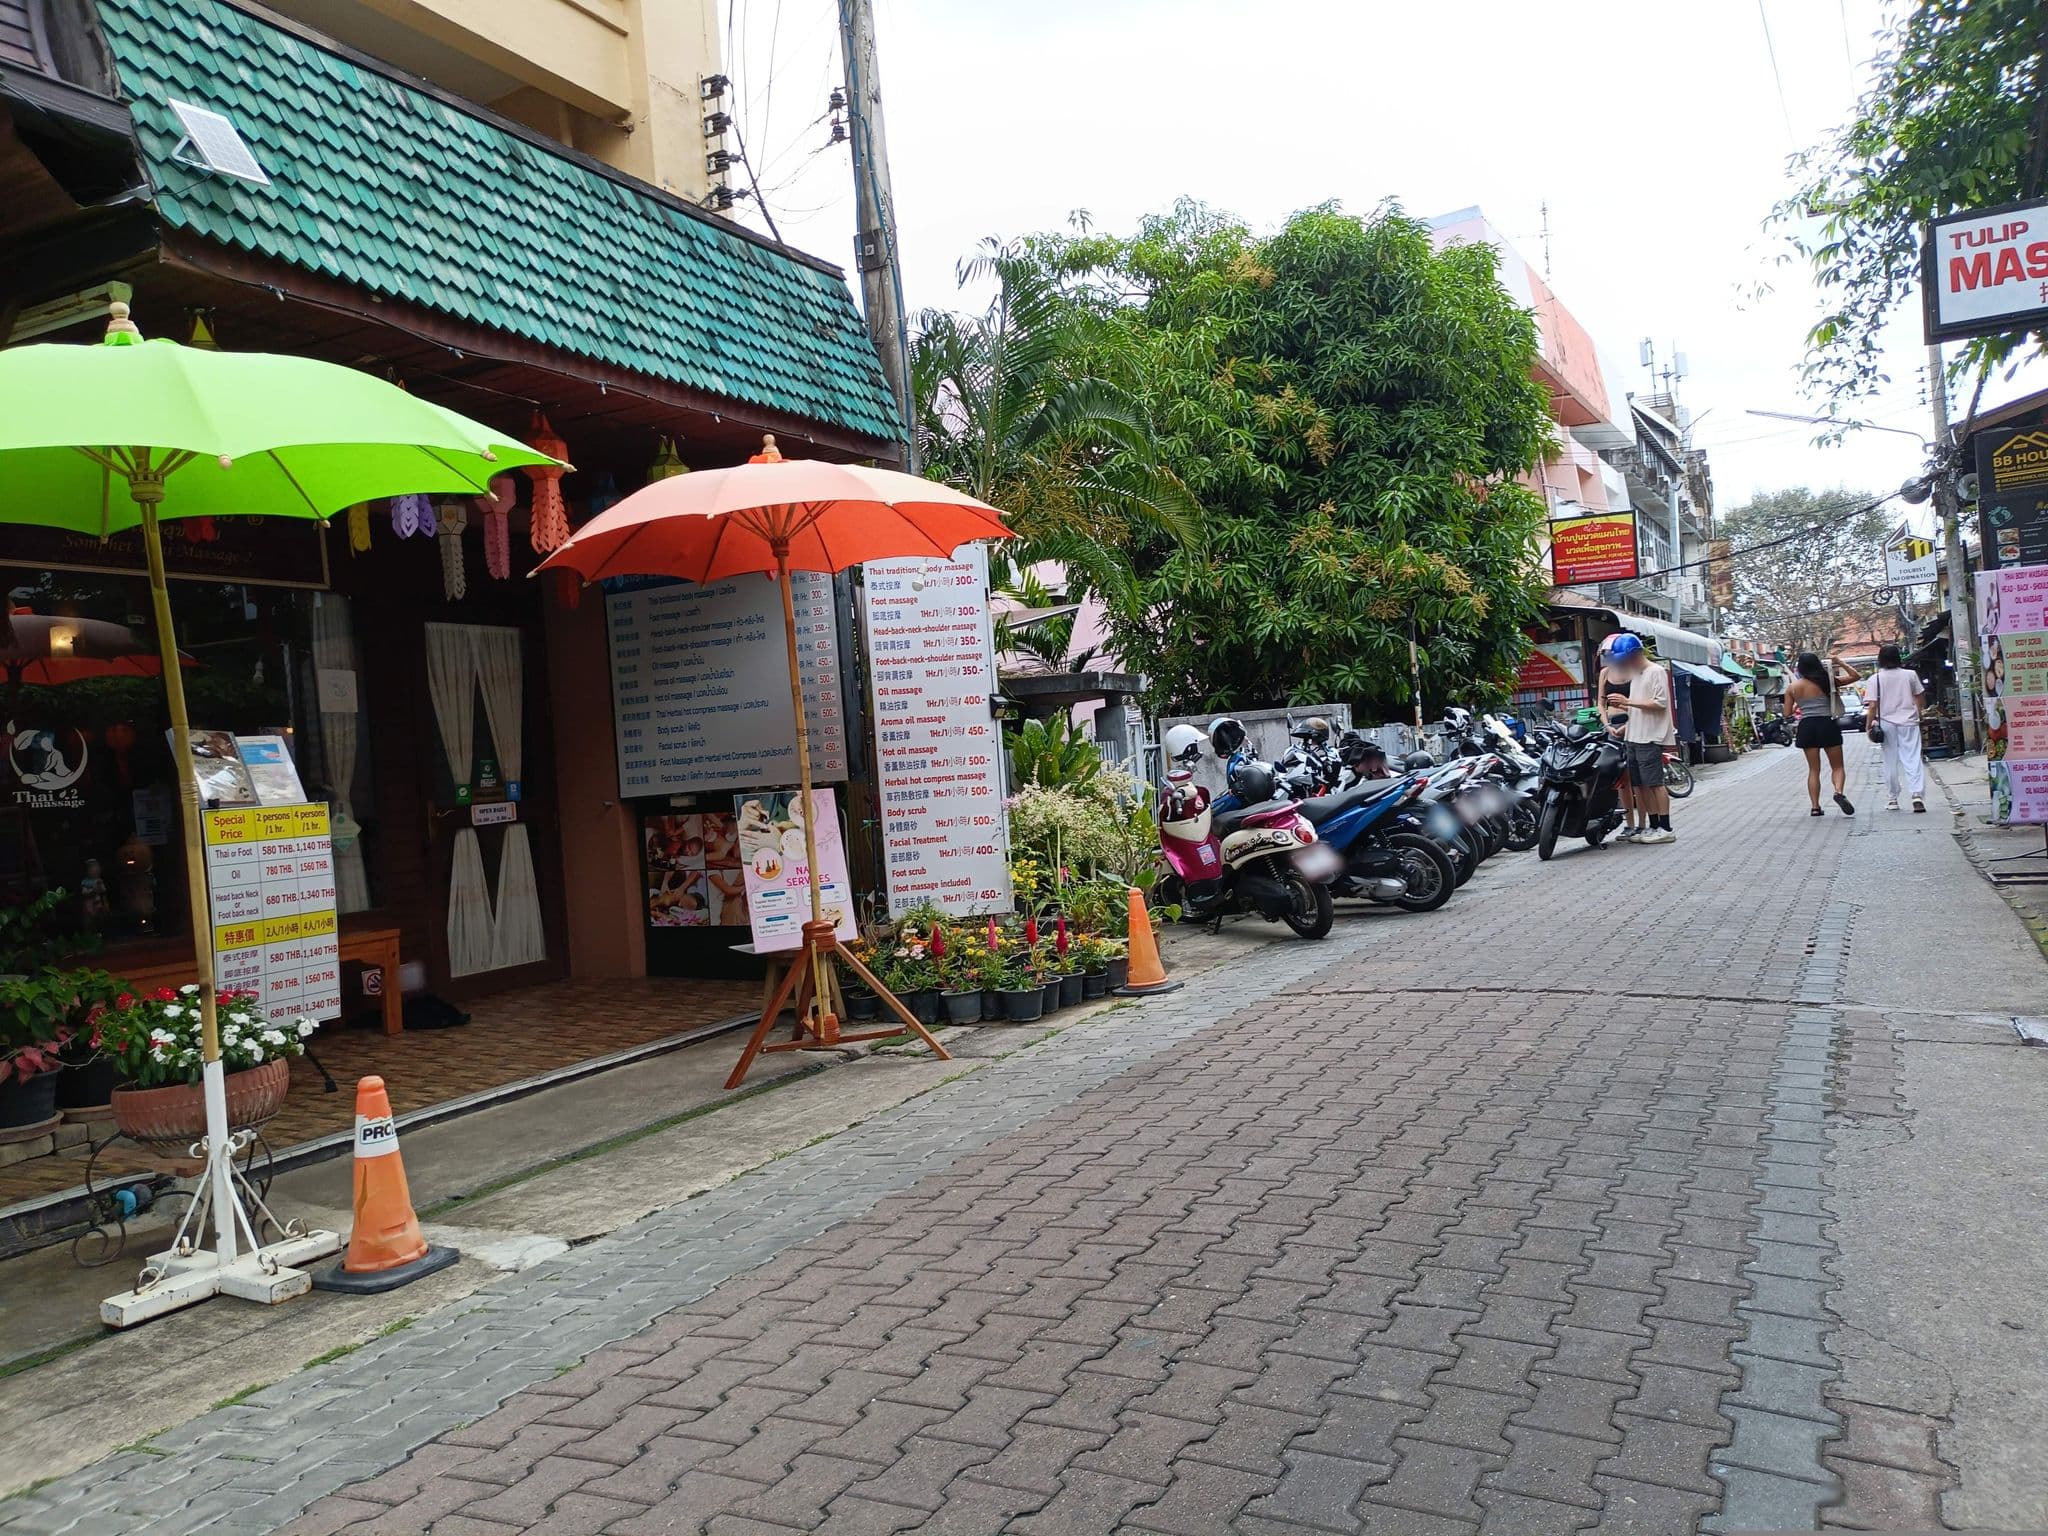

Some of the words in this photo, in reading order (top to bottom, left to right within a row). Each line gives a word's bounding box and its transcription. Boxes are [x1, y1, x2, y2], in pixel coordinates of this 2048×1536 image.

[1949, 221, 2029, 250] TULIP
[1949, 241, 2048, 293] MAS
[1993, 455, 2013, 468] BB
[868, 567, 884, 576] Thai
[944, 563, 974, 572] massage
[955, 575, 978, 586] 300.-
[1891, 573, 1935, 581] INFORMATION
[889, 596, 918, 606] massage
[957, 606, 981, 616] 300.-
[873, 623, 951, 636] Head-back-neck-shoulder
[952, 622, 977, 631] massage
[960, 636, 981, 646] 350.-
[875, 653, 955, 666] Foot-back-neck-shoulder
[956, 652, 983, 661] massage
[962, 665, 984, 675] 350.-
[878, 688, 889, 696] Oil
[891, 687, 923, 696] massage
[964, 695, 986, 705] 400.-
[881, 717, 904, 726] Aroma
[905, 716, 915, 724] oil
[917, 715, 946, 723] massage
[968, 726, 989, 736] 450.-
[882, 749, 895, 757] Hot
[897, 746, 907, 755] oil
[908, 746, 938, 755] massage
[968, 755, 991, 766] 500.-
[885, 777, 908, 787] Herbal
[909, 776, 922, 785] hot
[923, 774, 955, 784] compress
[957, 772, 986, 781] massage
[12, 790, 54, 803] Thai
[971, 786, 993, 796] 500.-
[31, 799, 85, 809] massage
[887, 808, 905, 818] Body
[907, 806, 927, 815] scrub
[214, 814, 246, 827] Special
[263, 812, 291, 823] persons
[300, 810, 326, 820] persons
[973, 816, 995, 826] 500.-
[220, 830, 243, 839] Price
[265, 825, 273, 835] /1
[275, 824, 285, 833] hr.
[302, 822, 309, 832] /1
[311, 820, 321, 831] hr.
[889, 837, 911, 847] Facial
[913, 835, 947, 845] Treatment
[215, 849, 230, 859] Thai
[238, 848, 253, 857] Foot
[262, 845, 277, 855] 580
[278, 843, 295, 854] THB.
[297, 841, 316, 852] 1,140
[976, 845, 999, 855] 400.-
[231, 869, 241, 880] Oil
[266, 866, 278, 876] 780
[280, 864, 294, 875] THB.
[300, 862, 315, 872] 1560
[316, 860, 329, 870] THB.
[892, 869, 907, 878] Foot
[908, 866, 927, 876] scrub
[786, 873, 831, 887] SERVES
[893, 884, 909, 894] (foot
[910, 881, 939, 891] massage
[940, 877, 971, 888] included)
[216, 891, 231, 901] Head
[231, 890, 245, 899] back
[246, 889, 259, 898] Neck
[266, 895, 281, 905] 680
[282, 893, 299, 904] THB.
[301, 891, 320, 901] 1,340
[980, 890, 1002, 900] 450.-
[218, 911, 231, 920] Foot
[232, 909, 245, 918] back
[246, 908, 259, 917] neck
[224, 928, 255, 945] 特惠價
[270, 953, 284, 963] 580
[285, 950, 303, 961] THB.
[304, 947, 322, 958] 1,140
[271, 981, 283, 991] 780
[284, 978, 300, 988] THB.
[305, 974, 320, 984] 1560
[322, 971, 336, 981] THB.
[270, 1008, 285, 1019] 680
[286, 1004, 303, 1016] THB.
[305, 1000, 325, 1012] 1,340
